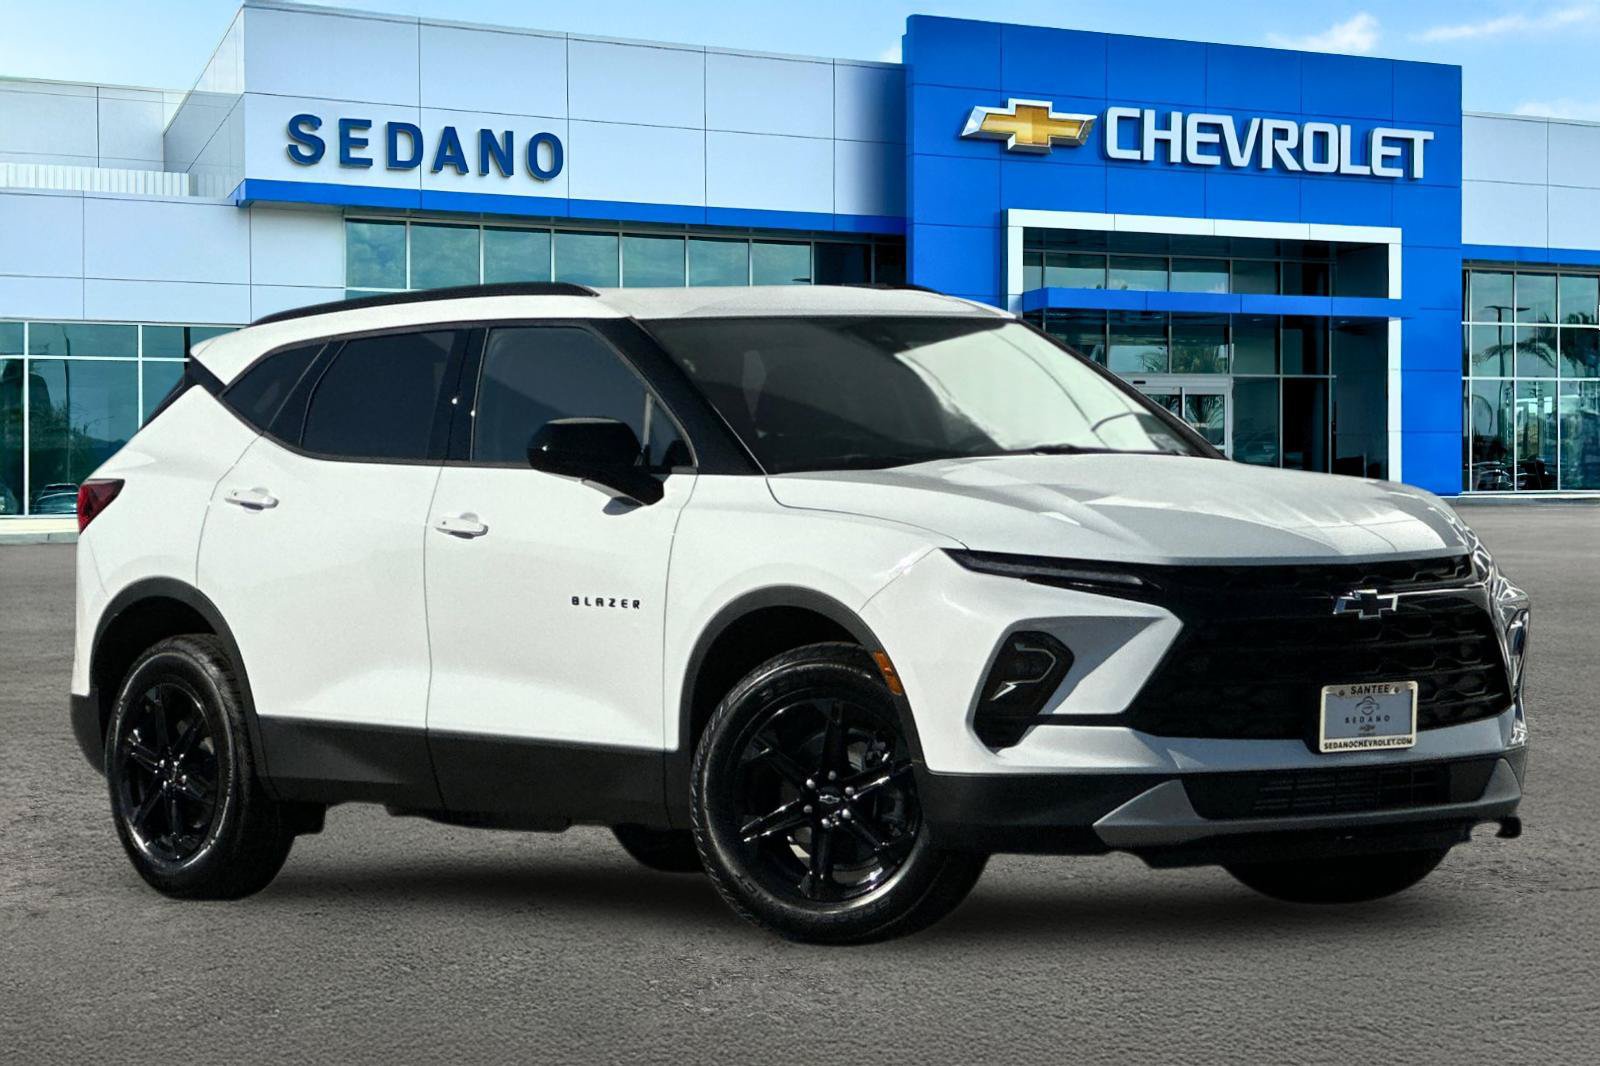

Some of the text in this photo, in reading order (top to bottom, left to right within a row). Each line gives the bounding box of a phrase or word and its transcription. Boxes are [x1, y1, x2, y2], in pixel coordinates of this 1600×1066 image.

[286, 113, 564, 181] SEDANO
[1105, 106, 1434, 179] CHEVROLET
[571, 596, 640, 609] BLAZER
[1350, 684, 1390, 695] SANTEE
[1345, 714, 1391, 724] SEDANO
[1323, 737, 1413, 750] SEDANOCHEVROLET.COM
